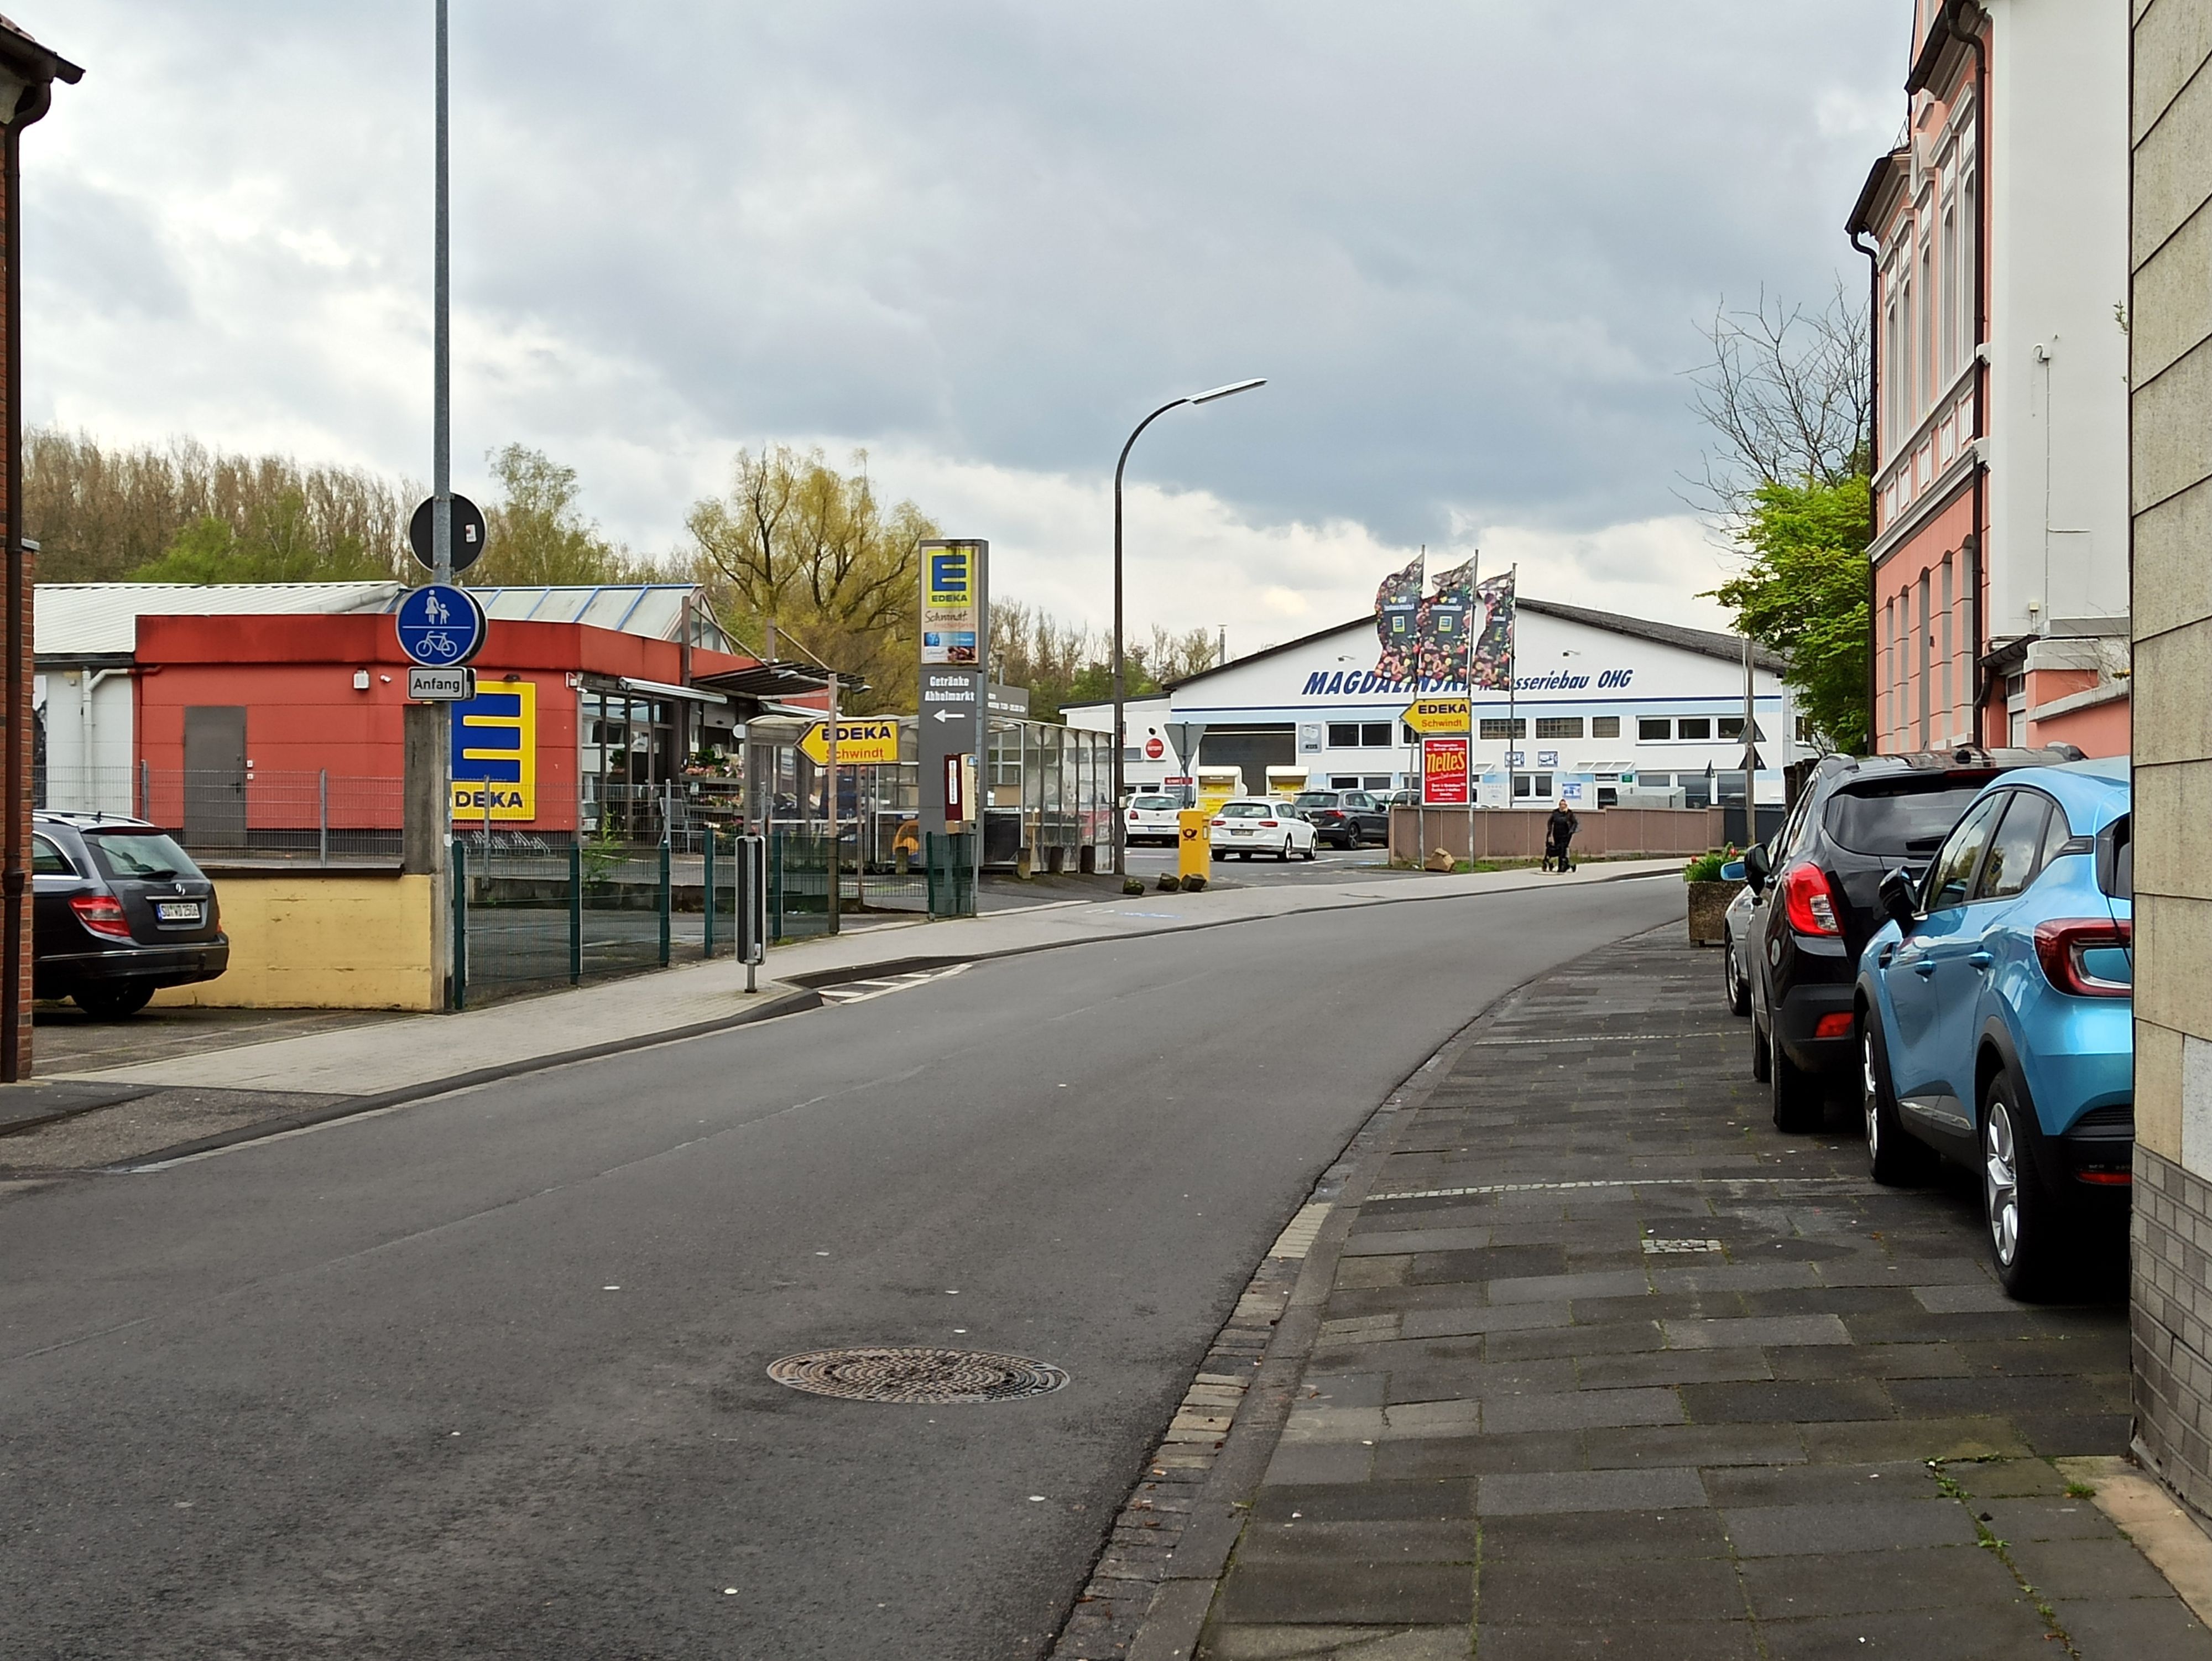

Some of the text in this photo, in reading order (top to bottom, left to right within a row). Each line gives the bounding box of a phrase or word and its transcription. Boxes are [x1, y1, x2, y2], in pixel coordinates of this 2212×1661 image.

[930, 676, 969, 687] Getränke
[1598, 669, 1634, 688] OHG
[414, 678, 460, 692] Anfang
[925, 691, 975, 701] Abholmarkt
[1418, 704, 1468, 714] EDEKA
[1421, 718, 1463, 728] Schwindt
[821, 726, 891, 741] EDEKA
[455, 791, 524, 809] DEKA
